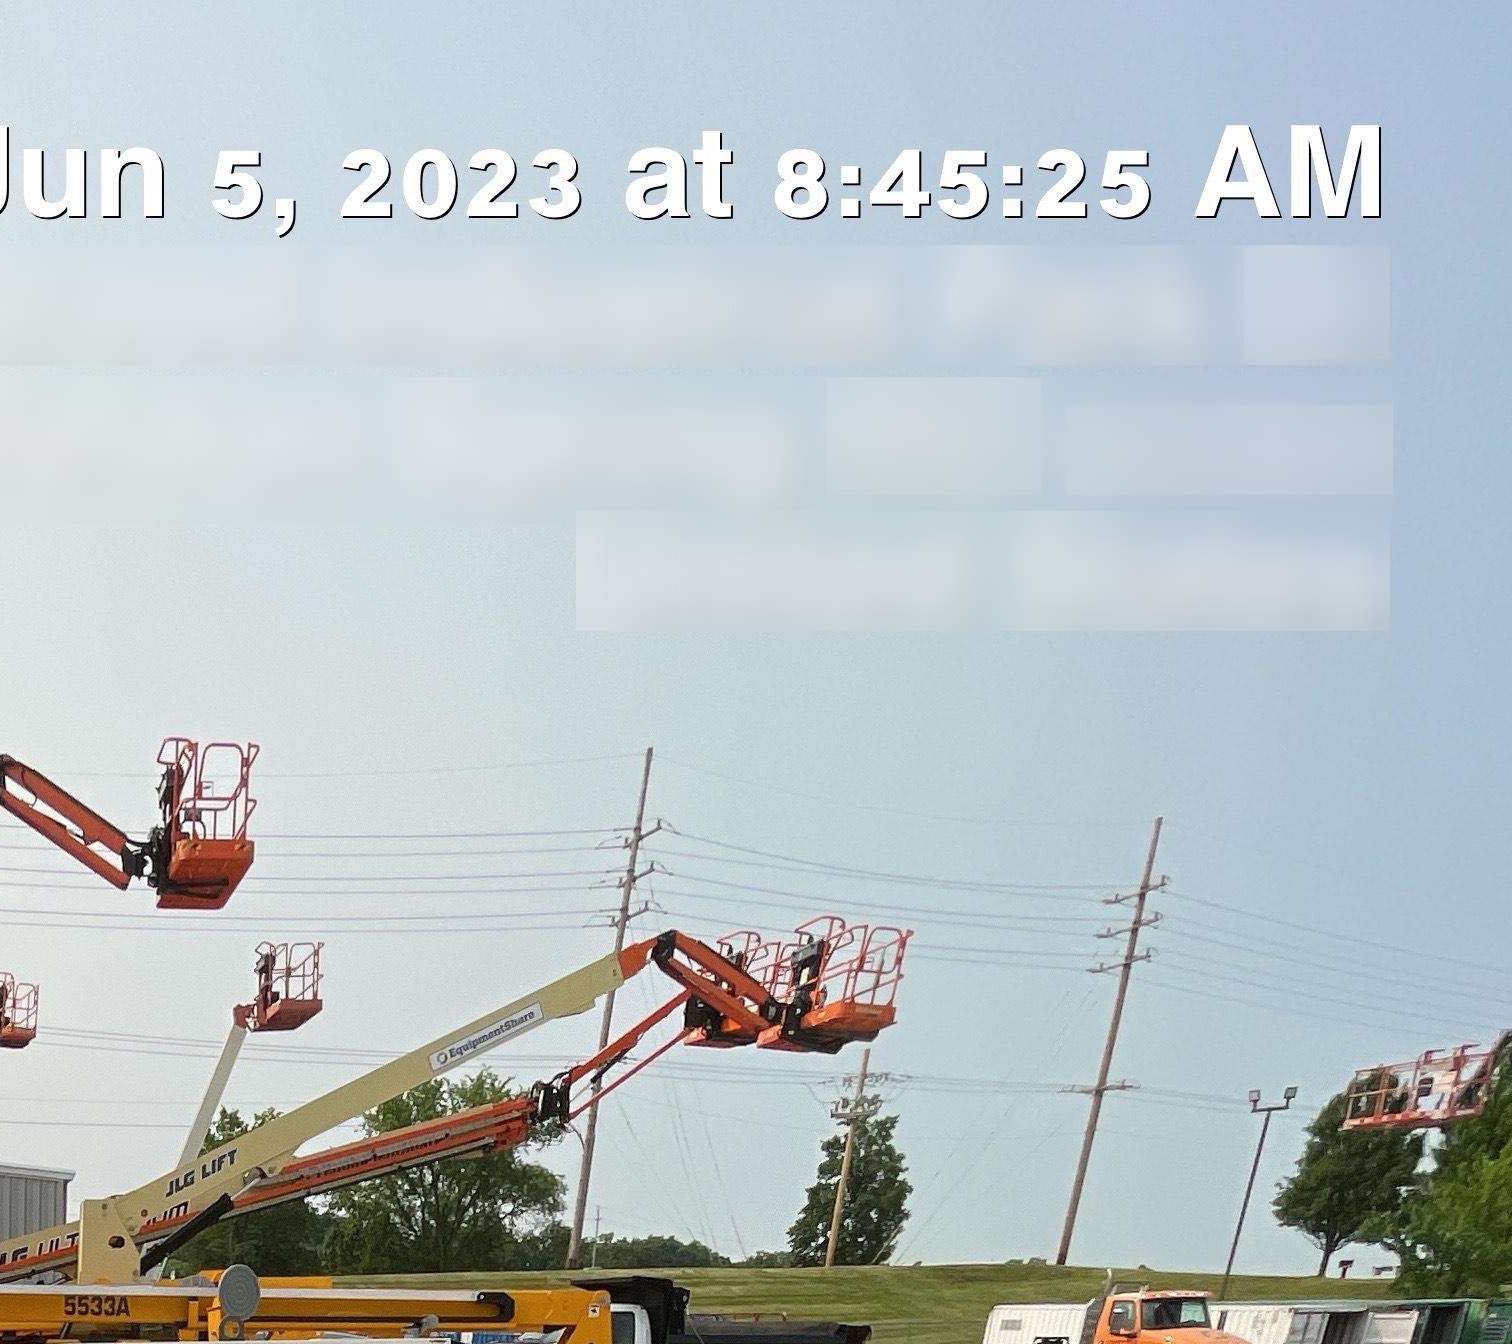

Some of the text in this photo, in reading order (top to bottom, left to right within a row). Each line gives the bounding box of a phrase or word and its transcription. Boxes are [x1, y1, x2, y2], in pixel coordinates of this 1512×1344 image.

[449, 1010, 536, 1058] EquipmentShare
[165, 1148, 237, 1198] JLG LIFT
[63, 1296, 131, 1317] 5533A
